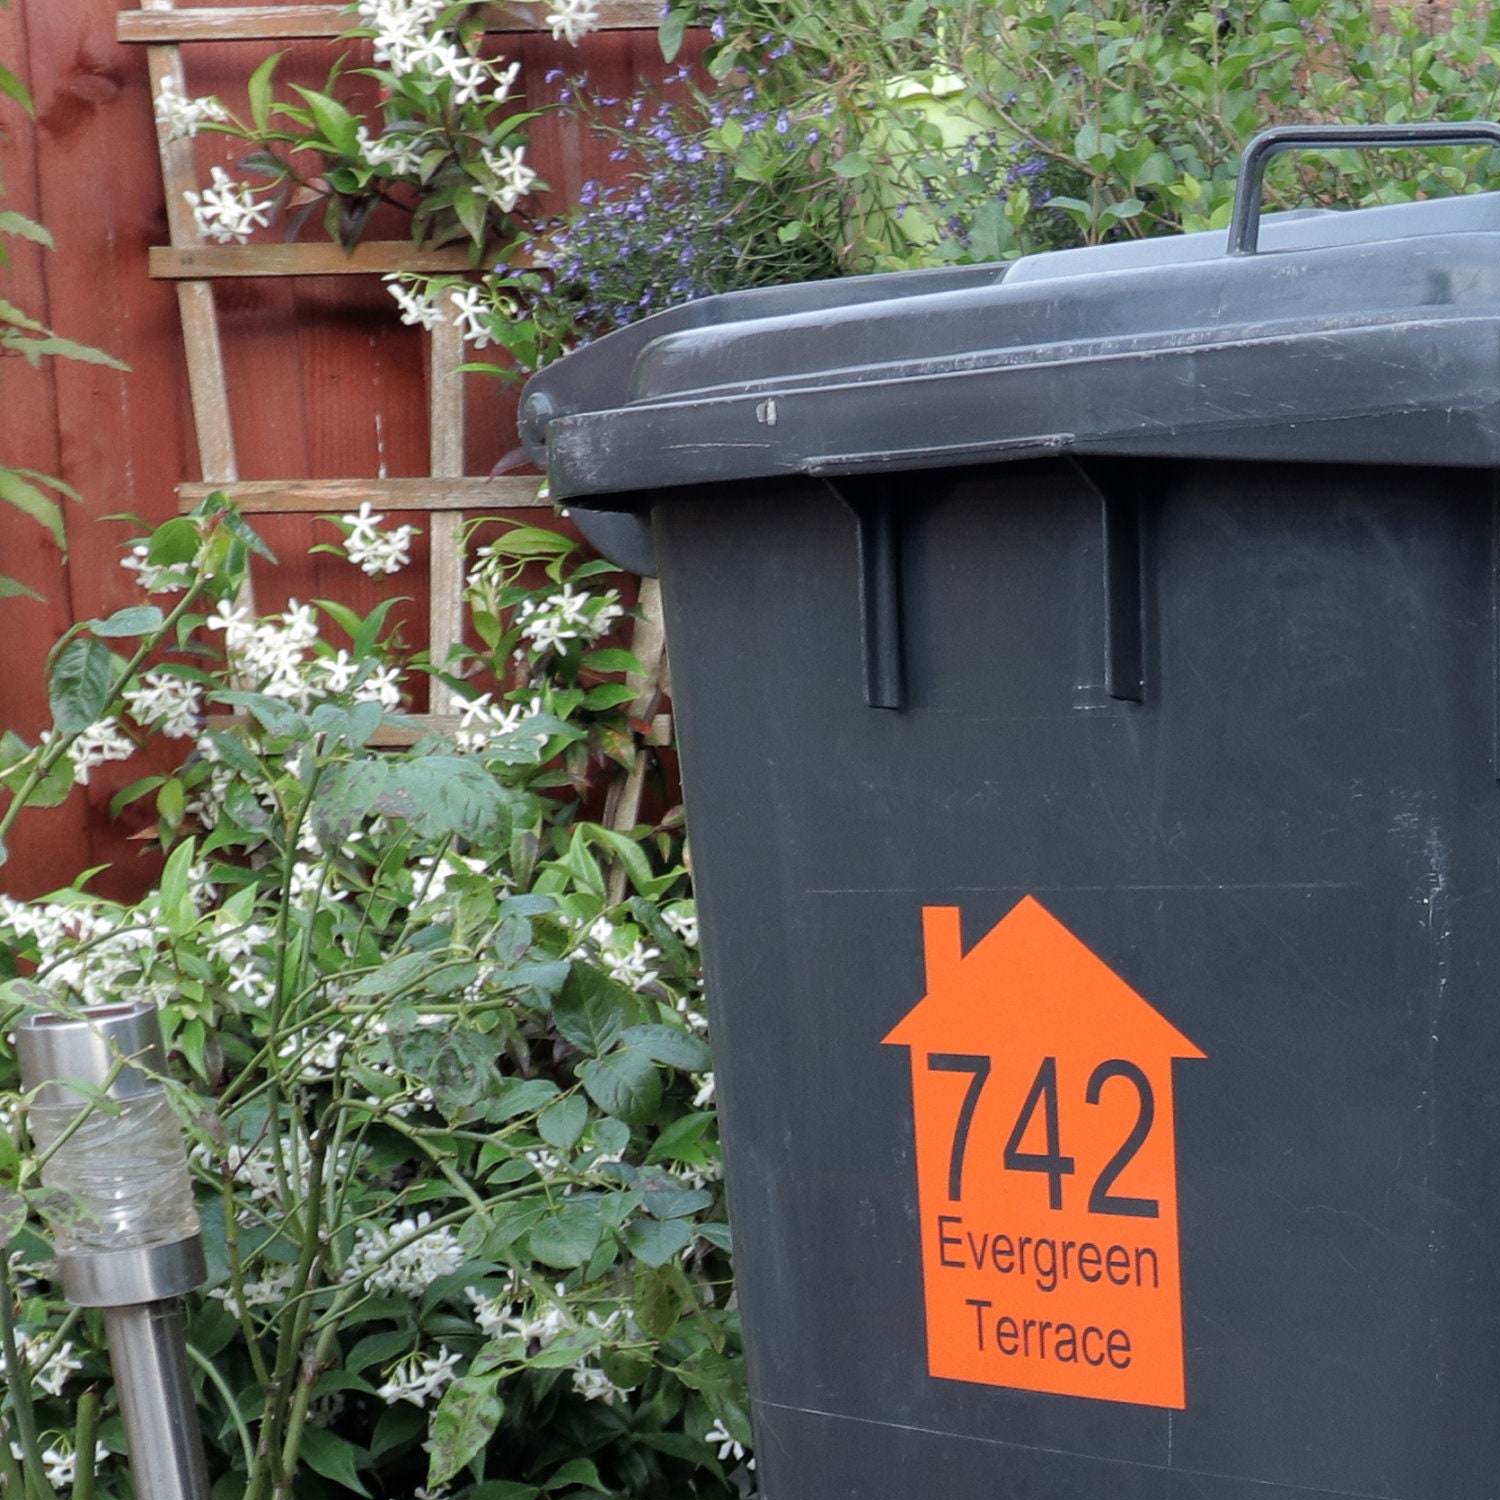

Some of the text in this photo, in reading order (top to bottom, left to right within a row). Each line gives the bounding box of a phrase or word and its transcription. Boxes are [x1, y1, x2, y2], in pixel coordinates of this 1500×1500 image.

[927, 1052, 1160, 1219] 742
[938, 1215, 1159, 1292] Evergreen
[965, 1298, 1132, 1370] Terrace
